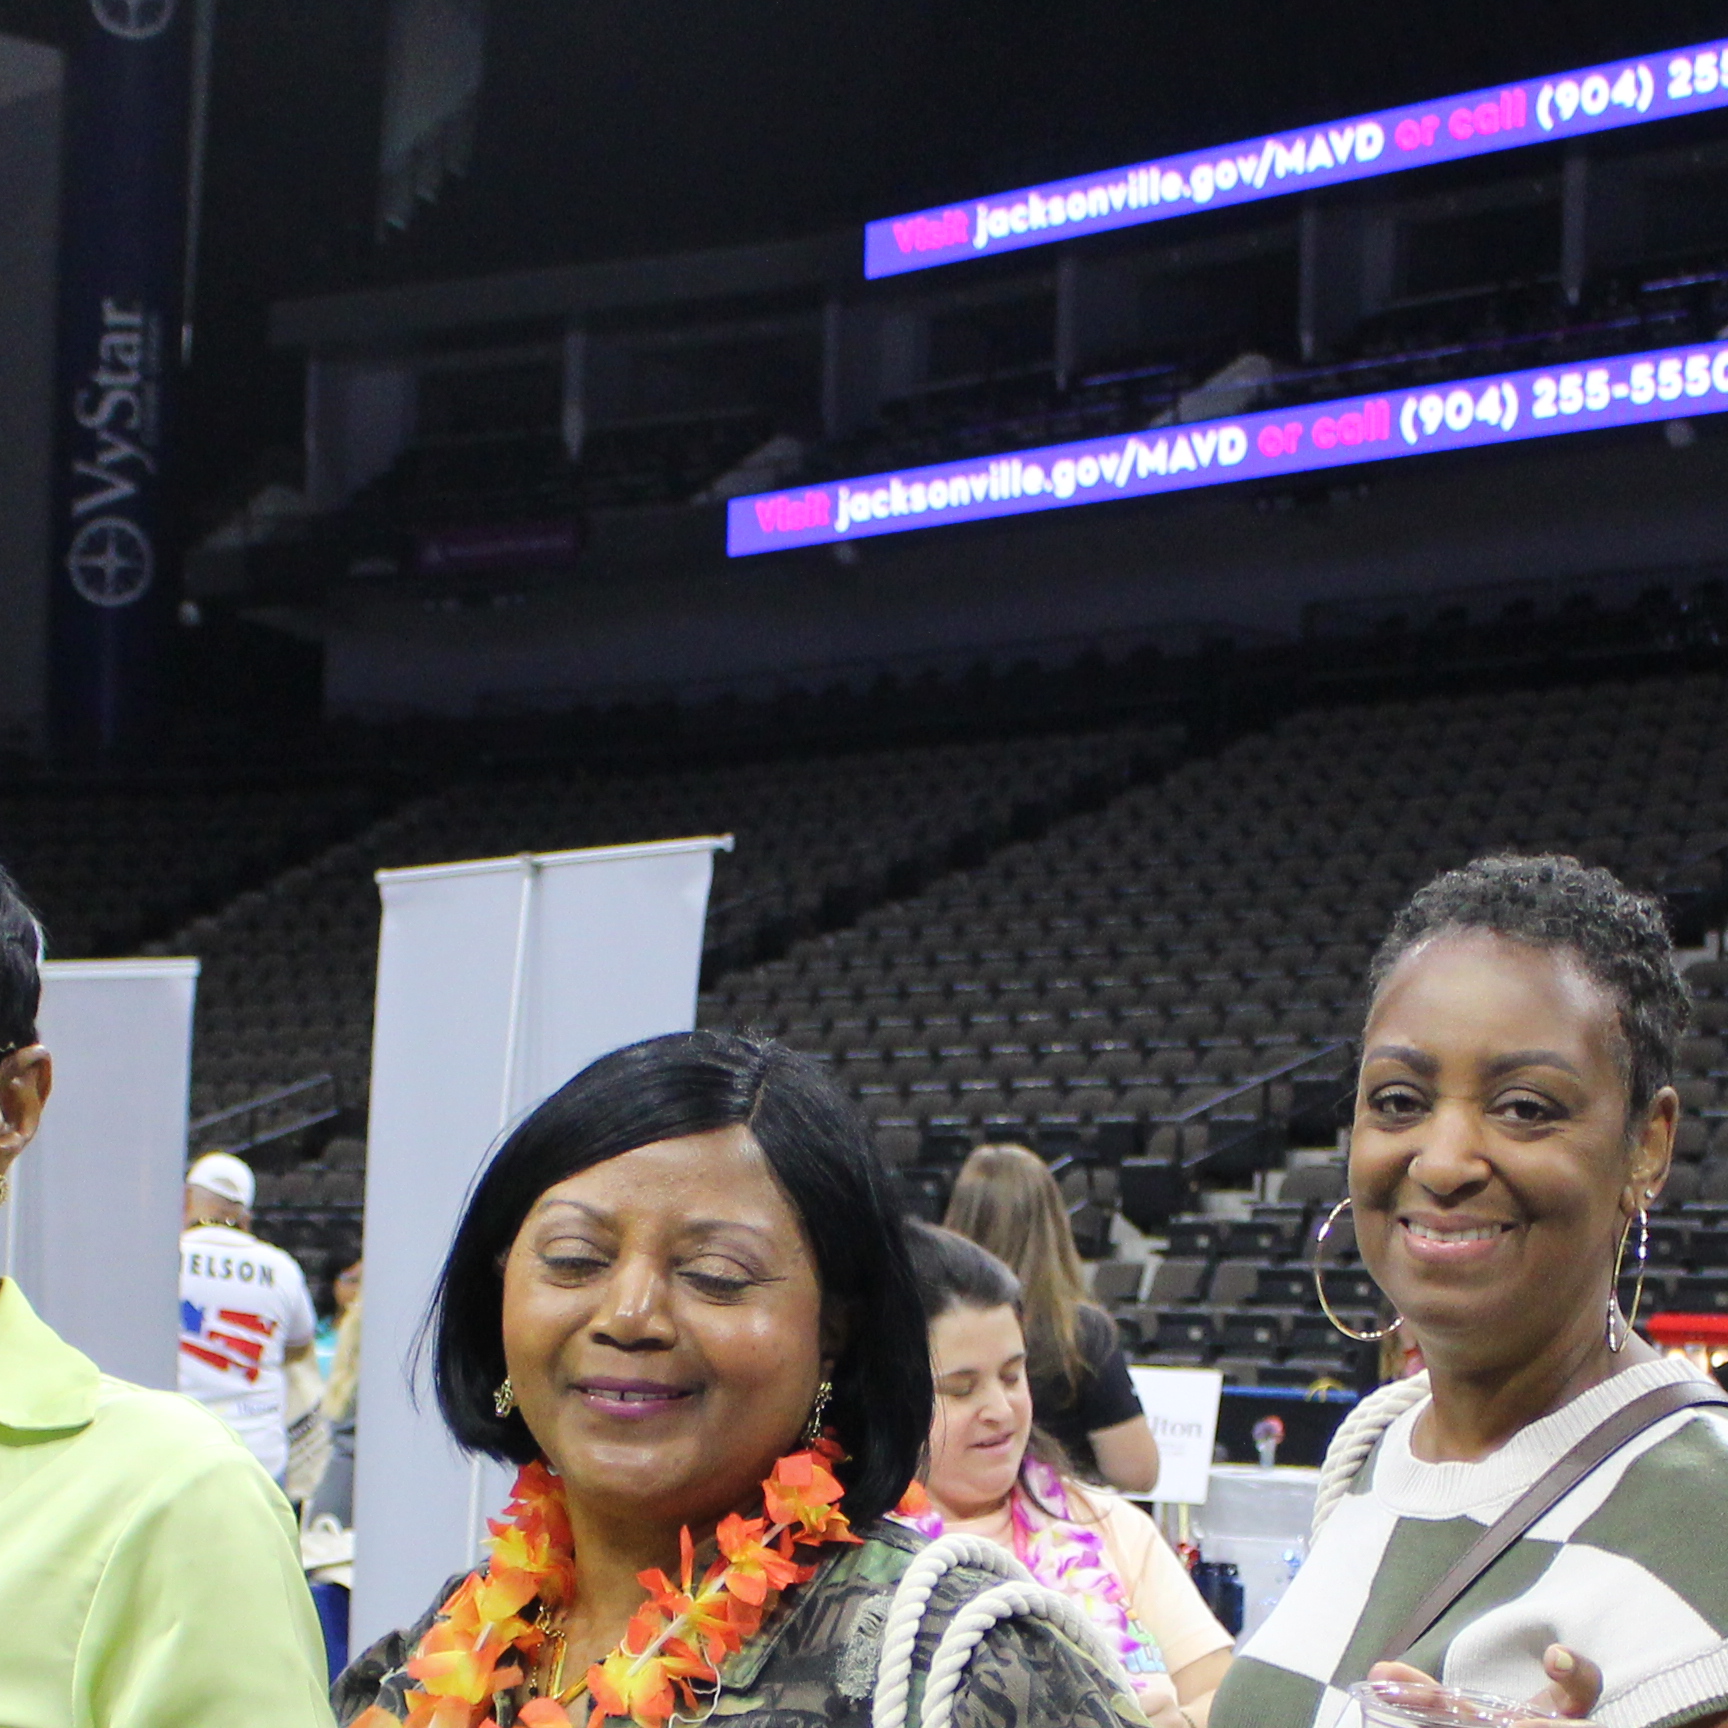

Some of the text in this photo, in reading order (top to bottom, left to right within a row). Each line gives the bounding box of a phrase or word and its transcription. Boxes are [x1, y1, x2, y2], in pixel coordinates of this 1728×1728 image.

[973, 120, 1385, 250] jacksonville.gov/MAVD
[1394, 113, 1440, 152] or
[1447, 86, 1527, 141] call
[1535, 64, 1654, 132] (904)
[73, 297, 159, 517] VyStar
[834, 425, 1248, 533] jacksonville.gov/MAVD
[1257, 421, 1303, 459] or
[1311, 398, 1391, 449] call
[1399, 380, 1519, 446] (904)
